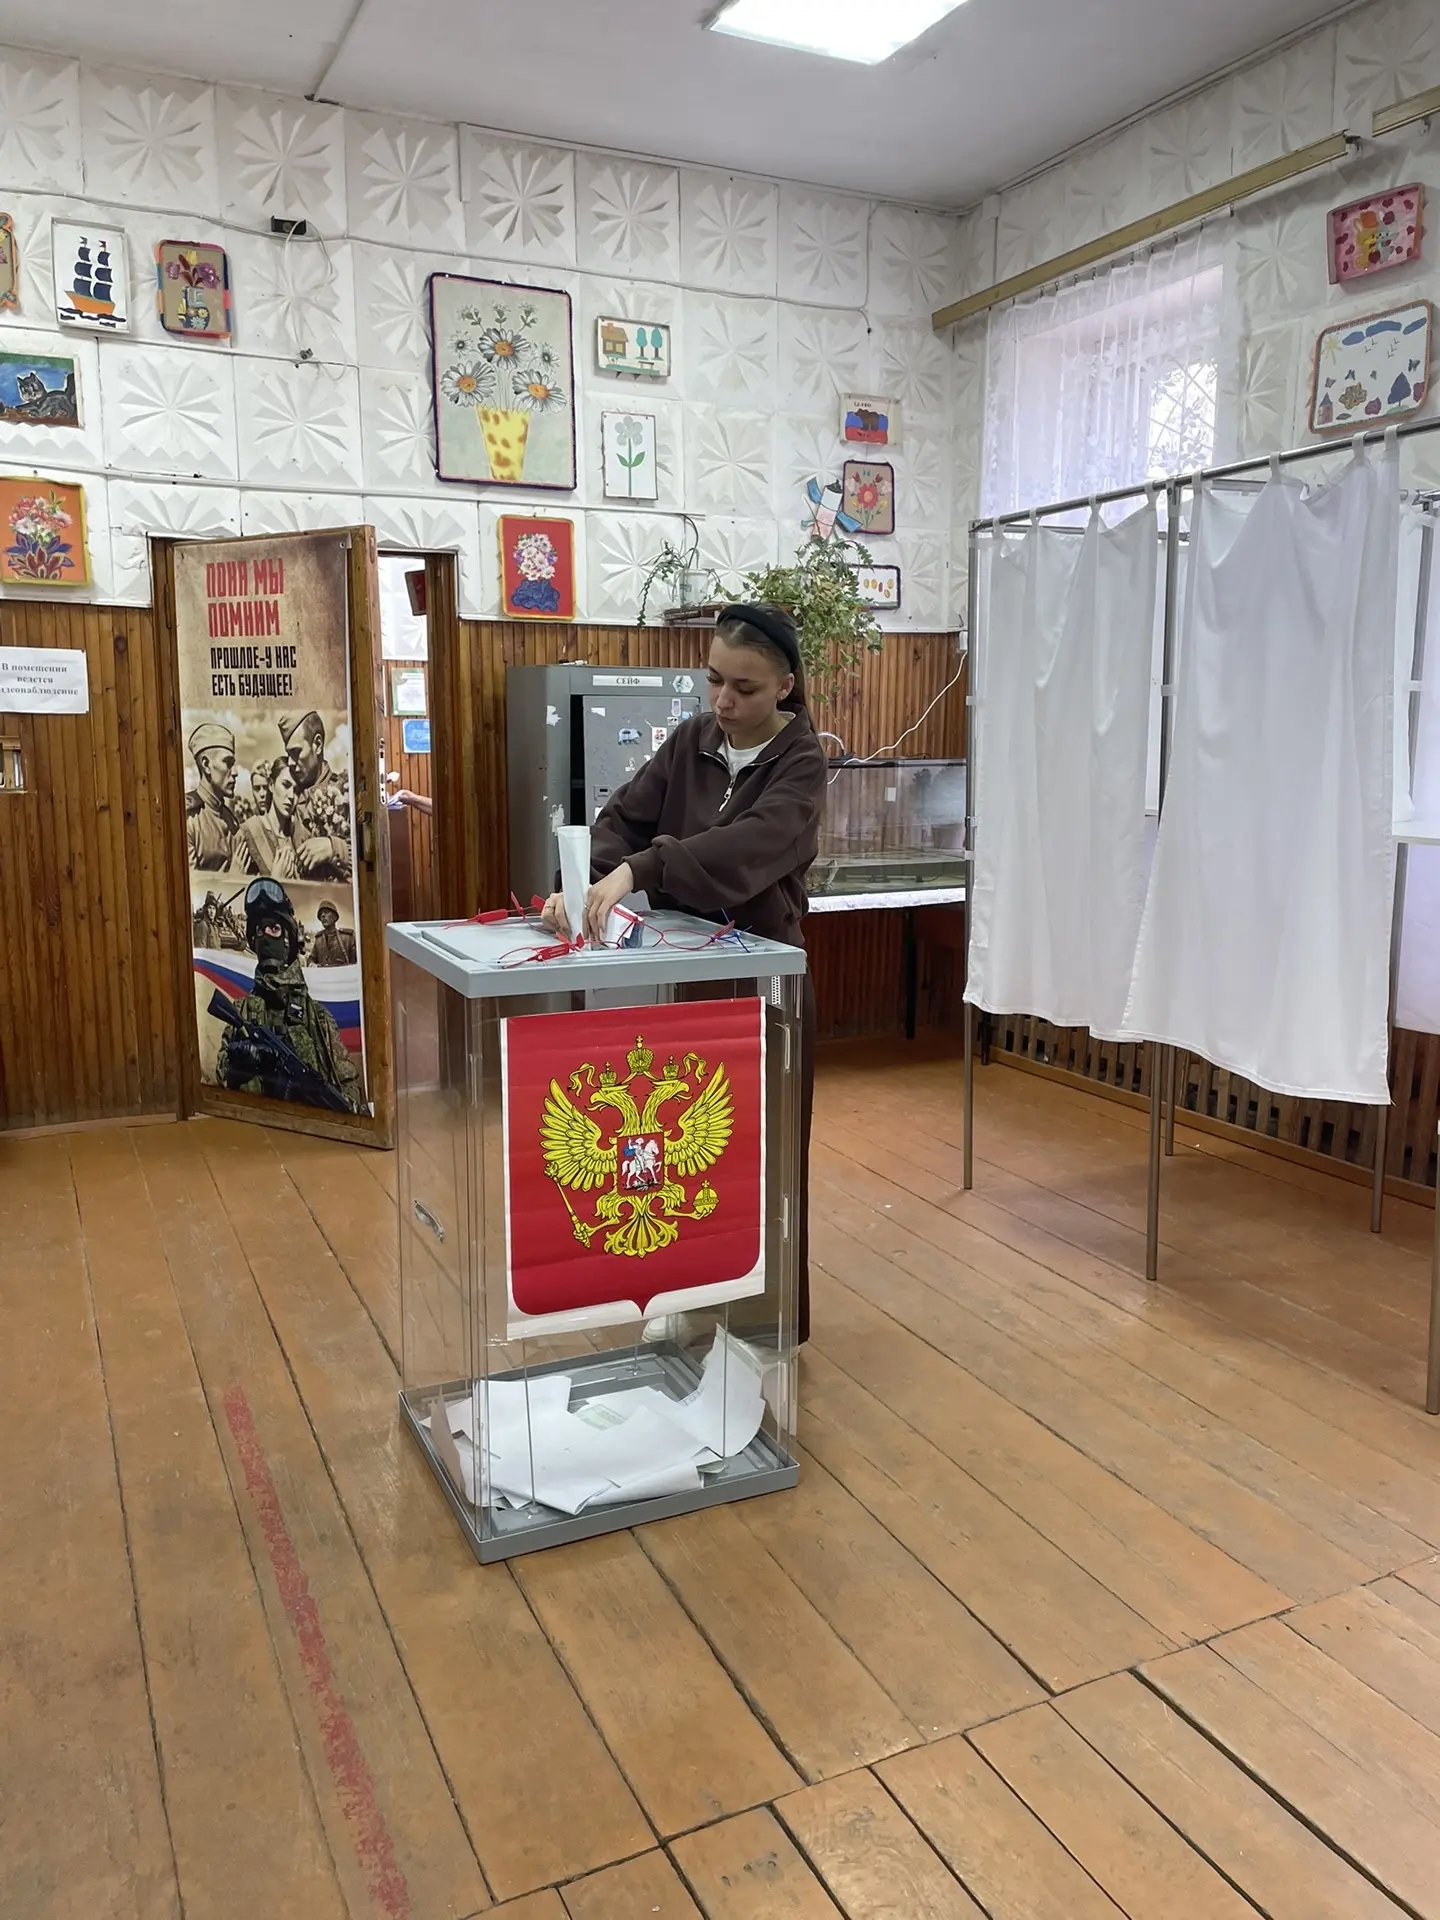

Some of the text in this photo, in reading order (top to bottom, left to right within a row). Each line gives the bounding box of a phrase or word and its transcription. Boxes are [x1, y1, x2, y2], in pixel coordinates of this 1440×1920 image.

[253, 558, 284, 595] МЫ
[208, 600, 280, 637] ПОМНИМ
[1, 662, 9, 671] В
[274, 646, 297, 668] НАС
[0, 686, 79, 695] деонаблюдение
[212, 674, 293, 698] ЕСТЬ БУДУЩЕЕ!
[616, 676, 640, 685] СЕЙФ
